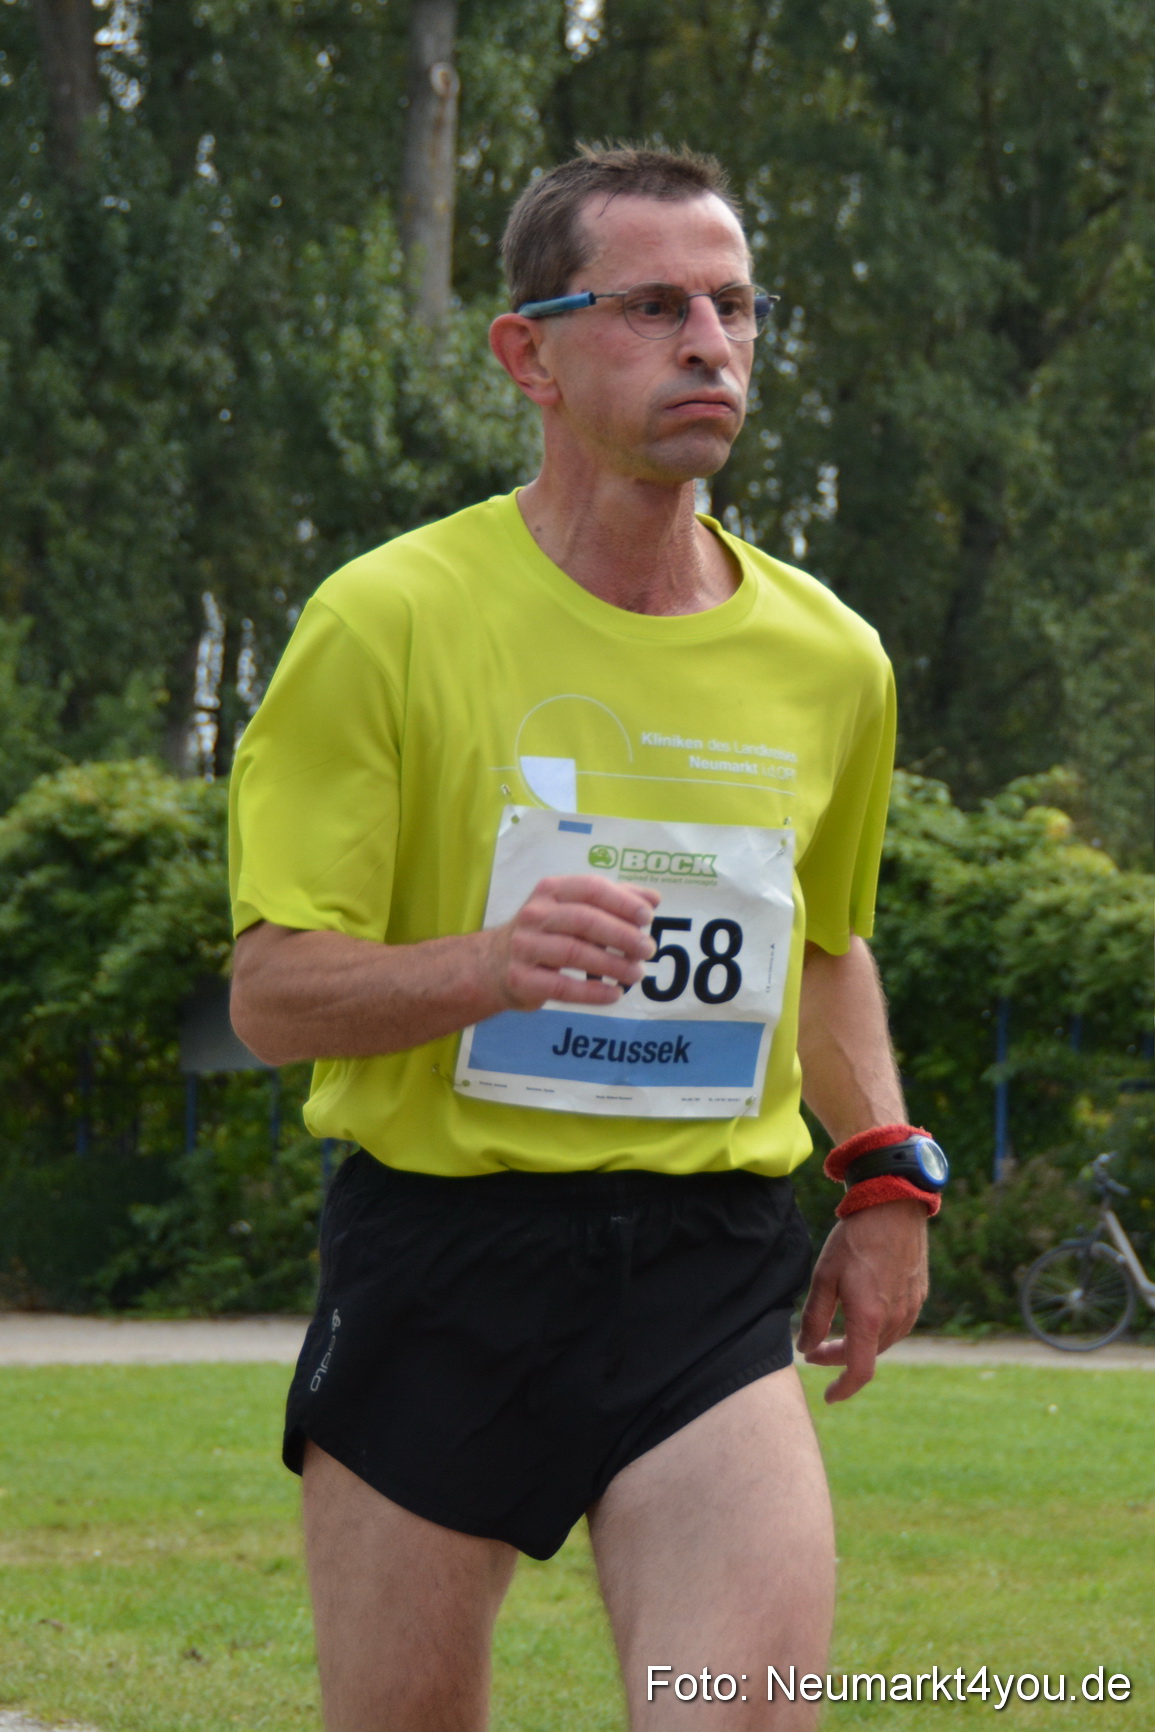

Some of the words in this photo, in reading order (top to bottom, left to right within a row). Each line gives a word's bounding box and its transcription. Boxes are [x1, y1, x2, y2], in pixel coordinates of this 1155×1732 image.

[641, 731, 703, 749] Kliniken
[708, 738, 731, 752] des
[689, 755, 758, 775] Neumarkt
[620, 848, 718, 877] BOCK
[552, 1026, 692, 1064] Jezussek
